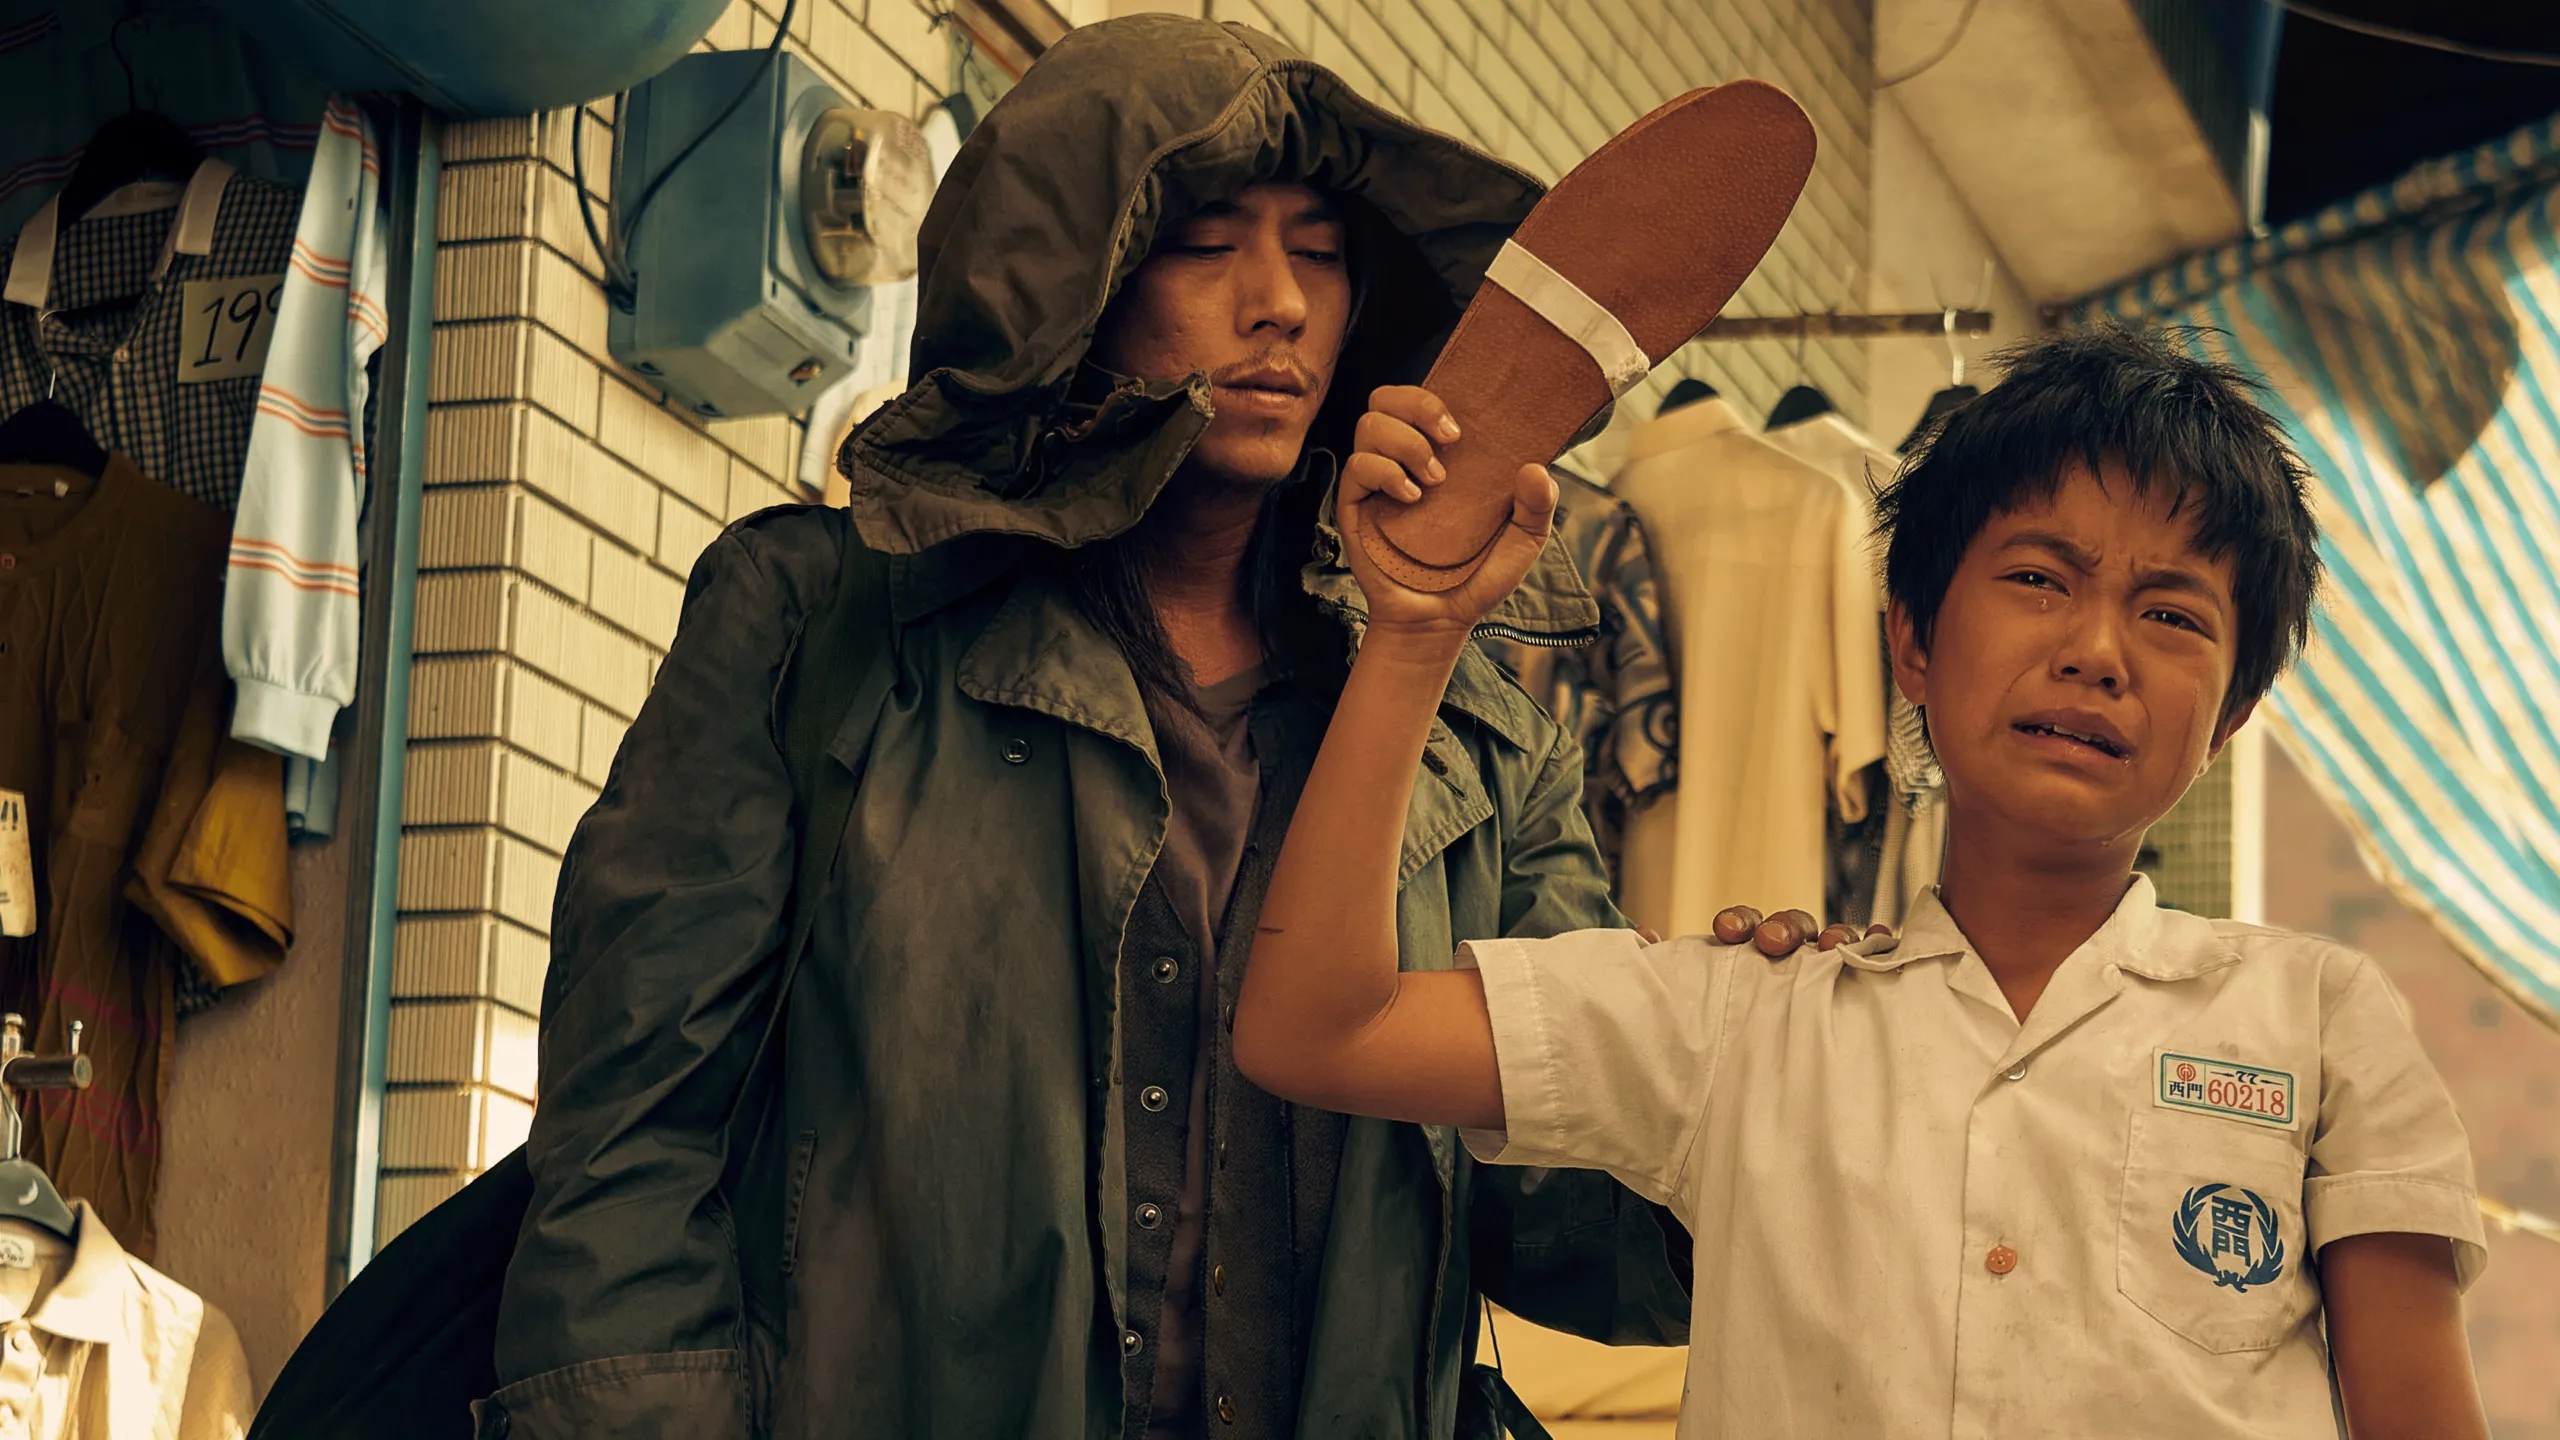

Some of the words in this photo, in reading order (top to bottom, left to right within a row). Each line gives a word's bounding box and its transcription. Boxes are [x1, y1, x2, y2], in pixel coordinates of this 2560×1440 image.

[2168, 1080, 2203, 1100] 西門
[2235, 1070, 2259, 1085] 77
[2207, 1079, 2285, 1116] 60218
[2211, 1195, 2253, 1268] 西門
